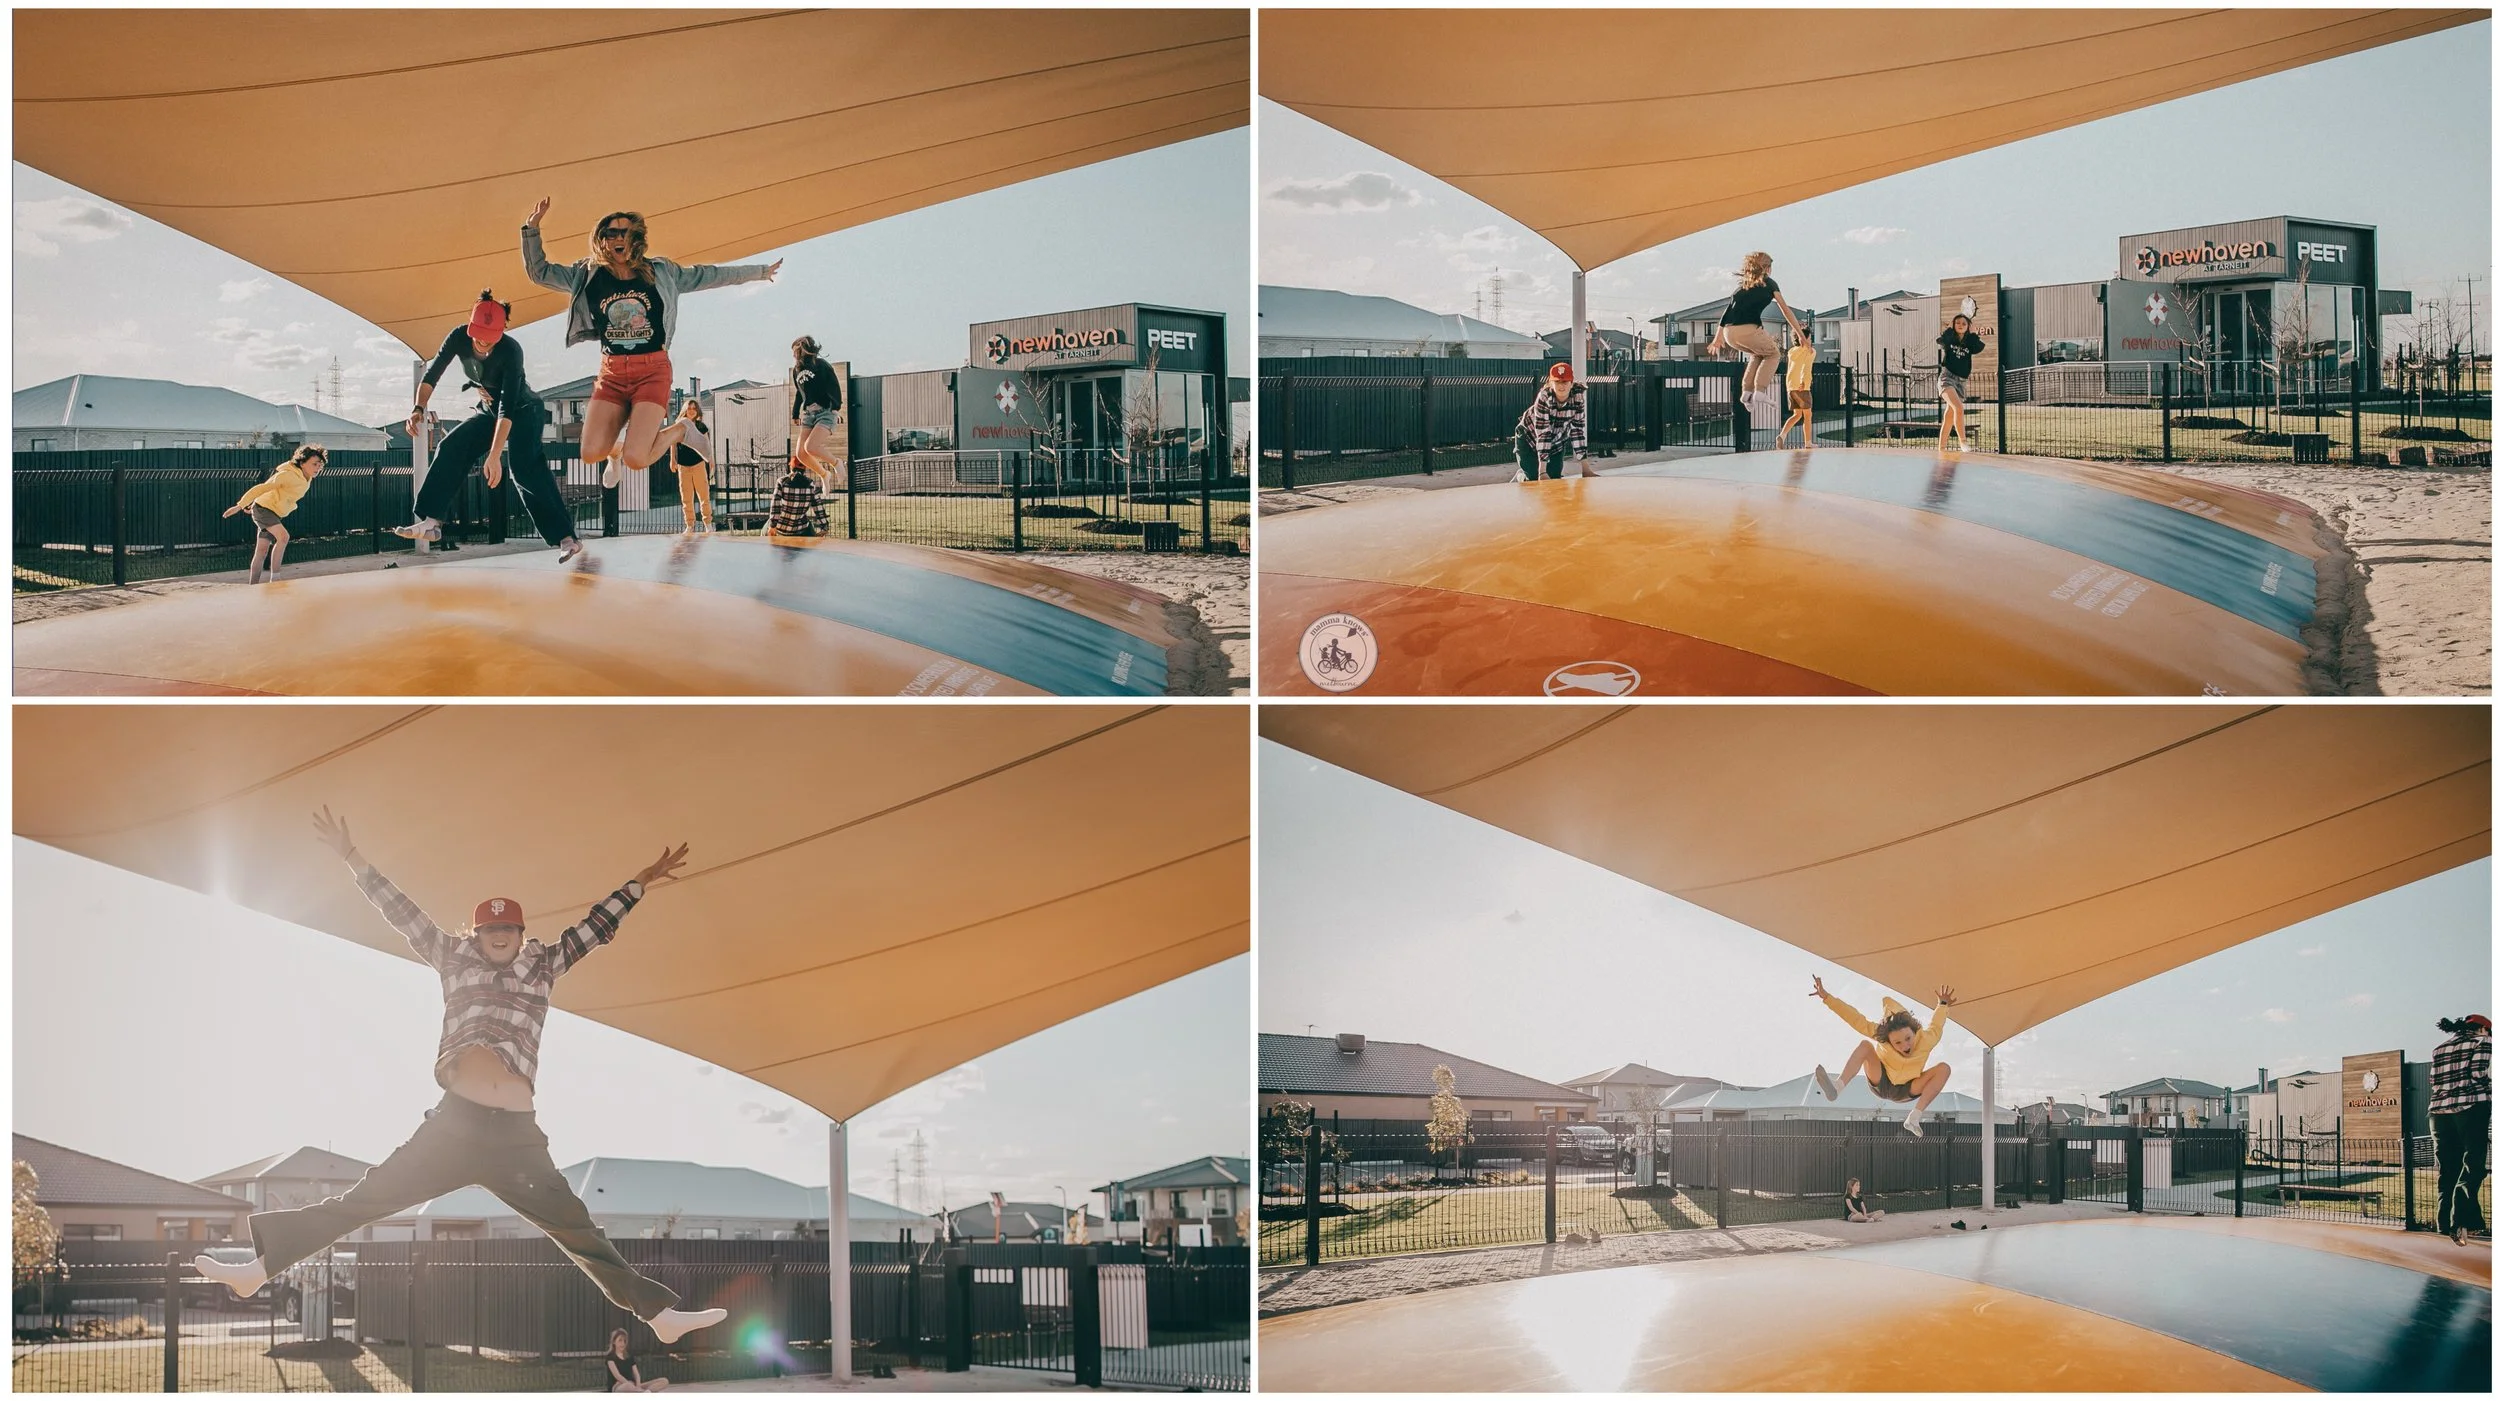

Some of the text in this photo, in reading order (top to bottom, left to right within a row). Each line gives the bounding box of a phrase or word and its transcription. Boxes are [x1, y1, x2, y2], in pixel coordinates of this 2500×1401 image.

[2159, 239, 2268, 267] newhaven
[2297, 241, 2348, 263] PEET
[2203, 260, 2249, 272] AT TARNEIT
[607, 329, 652, 338] DESERT LIGHTS
[1009, 327, 1118, 355] newhaven
[1147, 328, 1198, 350] PEET
[1054, 349, 1100, 360] AT TARNEIT
[2348, 1095, 2397, 1108] newhaven
